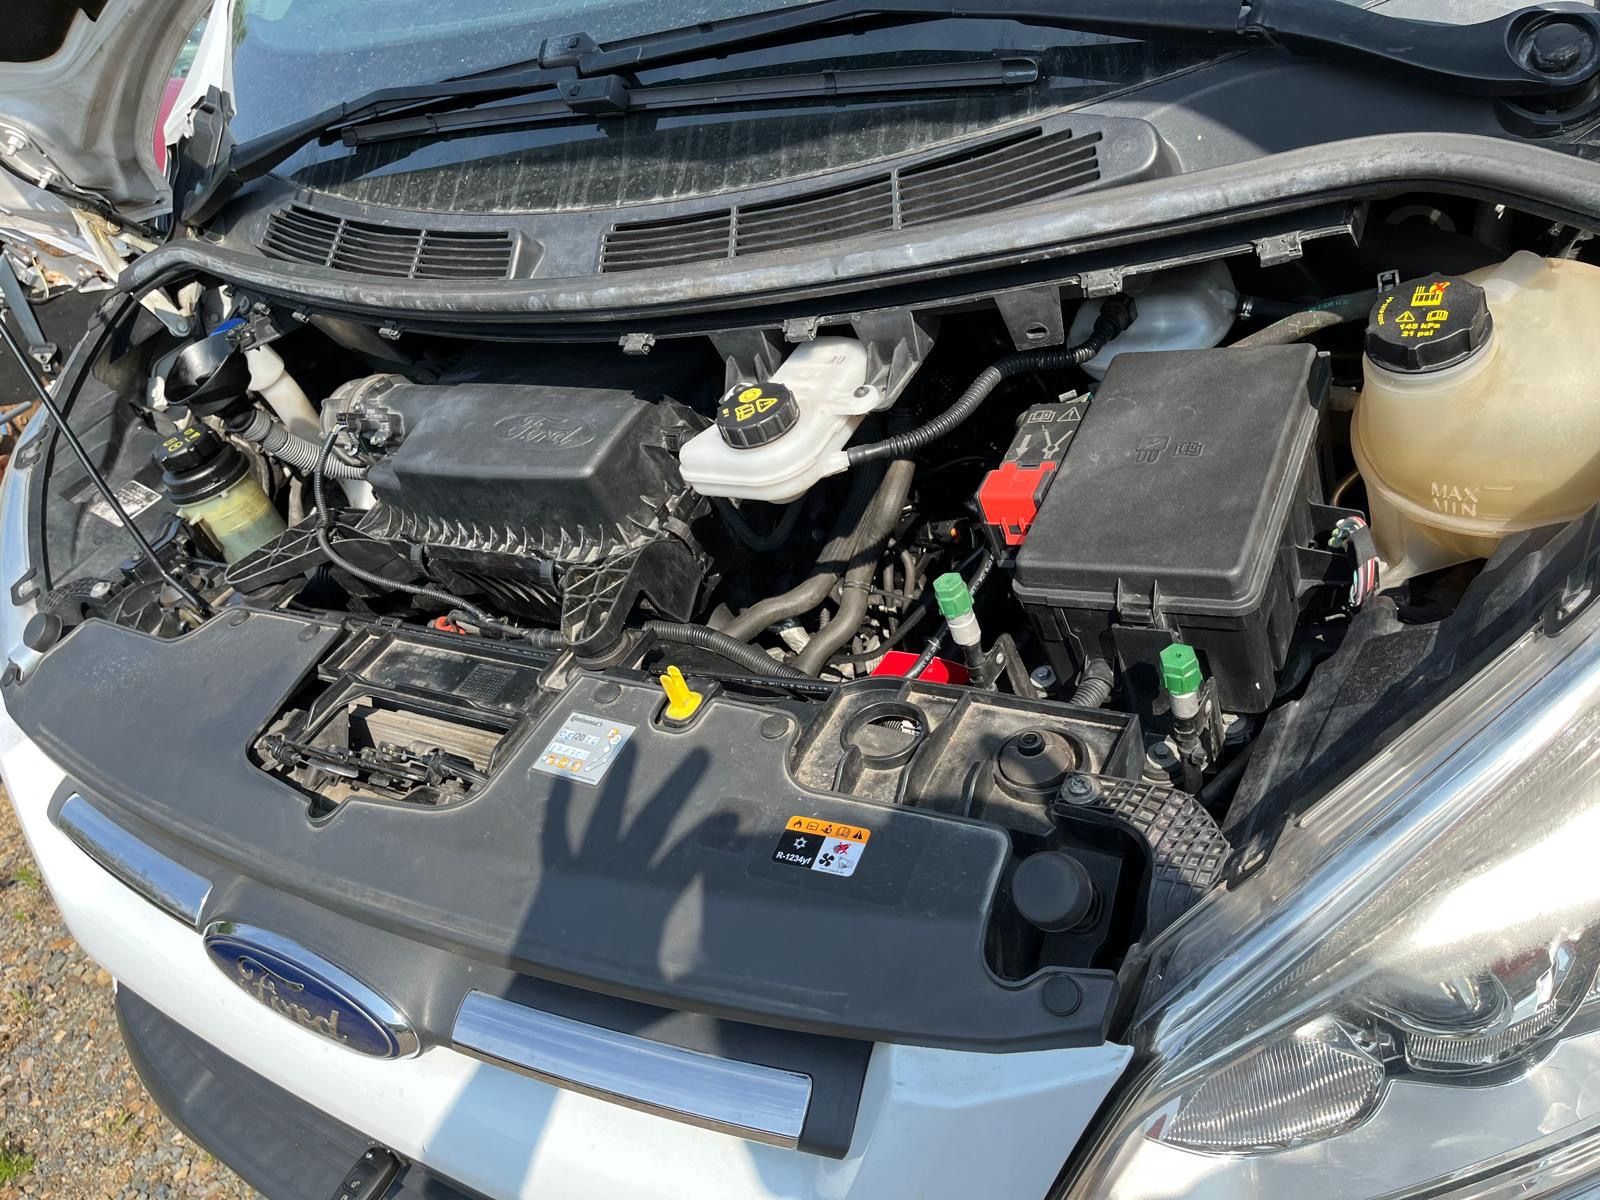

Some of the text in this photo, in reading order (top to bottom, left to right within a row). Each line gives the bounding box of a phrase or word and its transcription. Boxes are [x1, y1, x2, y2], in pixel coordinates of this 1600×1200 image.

[1399, 322, 1441, 331] 145 kPa
[1400, 329, 1434, 338] 21 psi
[505, 415, 583, 446] Ford
[1430, 481, 1480, 503] MAX
[1432, 497, 1477, 517] MIN
[775, 850, 813, 866] R-1234yf
[236, 955, 350, 1043] Ford
